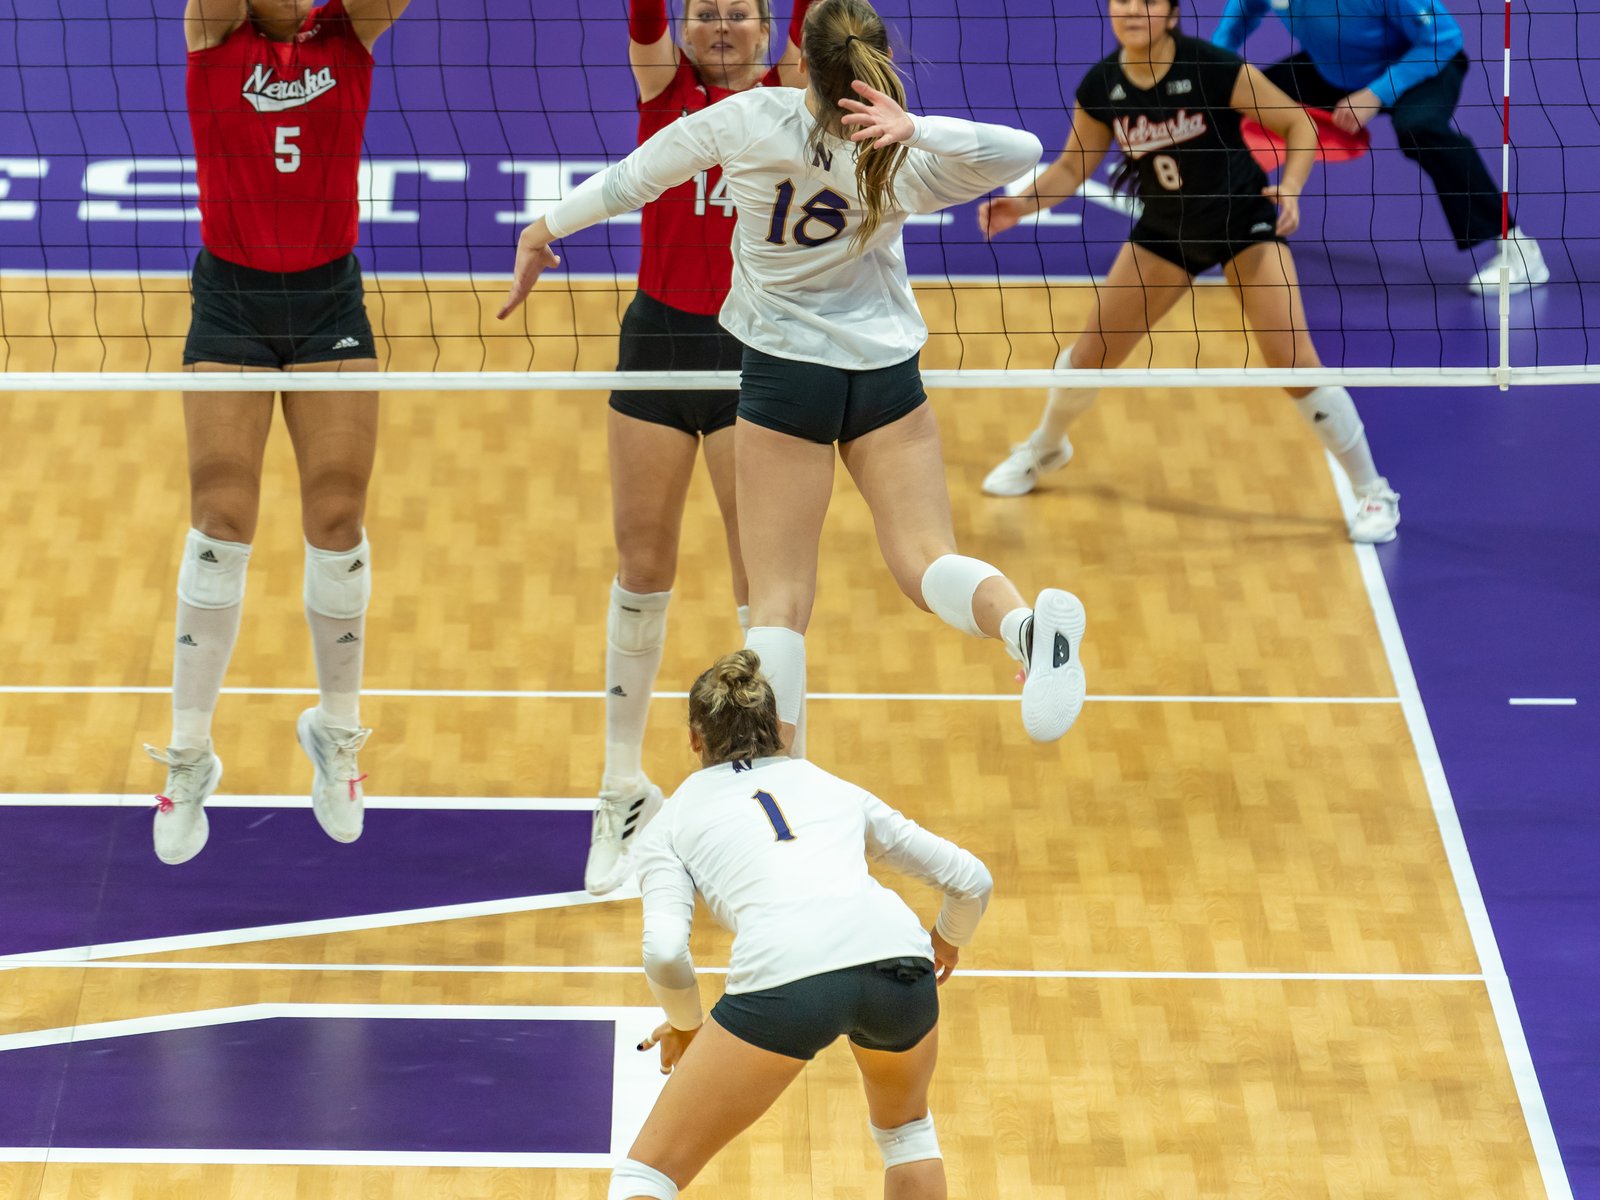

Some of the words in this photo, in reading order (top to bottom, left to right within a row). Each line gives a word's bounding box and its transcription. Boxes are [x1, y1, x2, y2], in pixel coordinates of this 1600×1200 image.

[275, 125, 301, 174] 5
[1112, 110, 1207, 154] Nebraska
[692, 169, 736, 218] 14
[1152, 154, 1183, 191] 8
[764, 177, 851, 247] 18
[750, 788, 798, 843] 1
